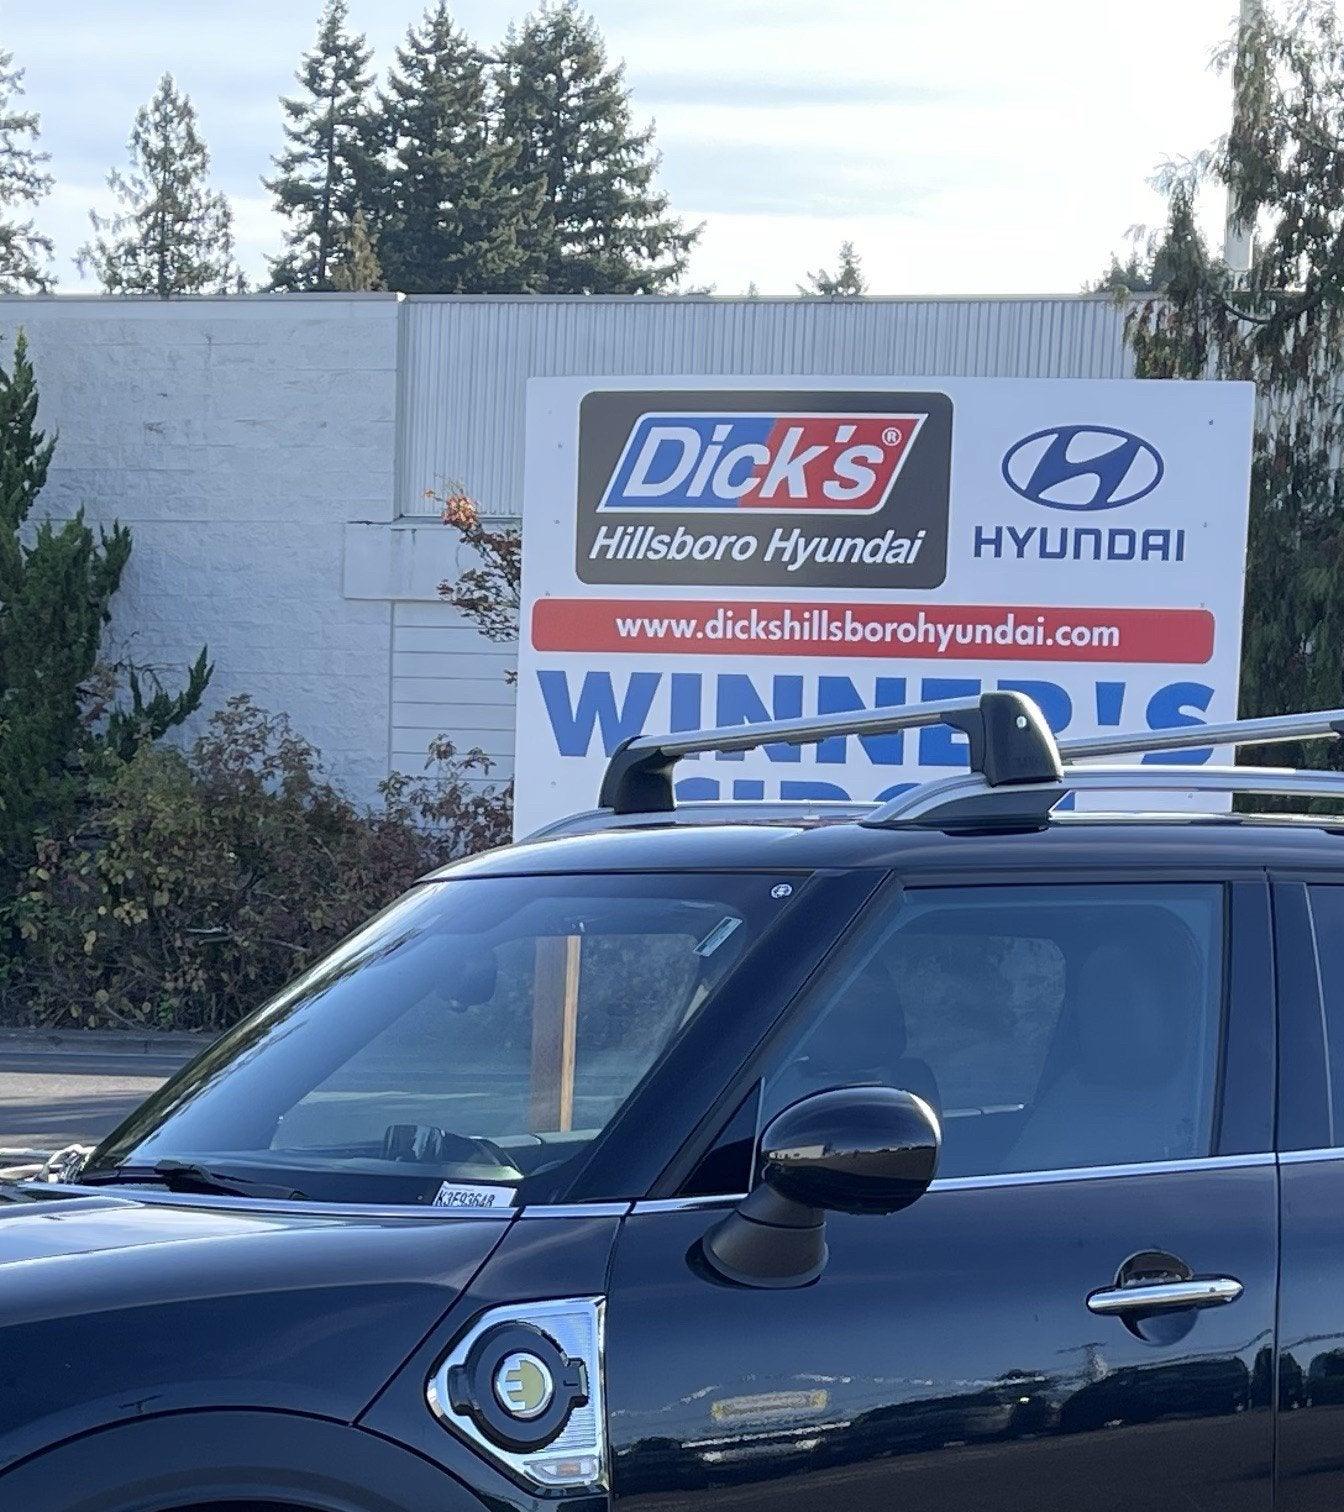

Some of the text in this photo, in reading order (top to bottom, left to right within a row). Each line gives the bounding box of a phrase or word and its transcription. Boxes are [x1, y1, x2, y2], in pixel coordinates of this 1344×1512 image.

[622, 421, 883, 500] Dick's
[588, 525, 926, 569] Hillsboro Hyundai
[974, 525, 1186, 562] HYUNDAI
[616, 603, 1120, 652] www.dickshillsborohyundai.com
